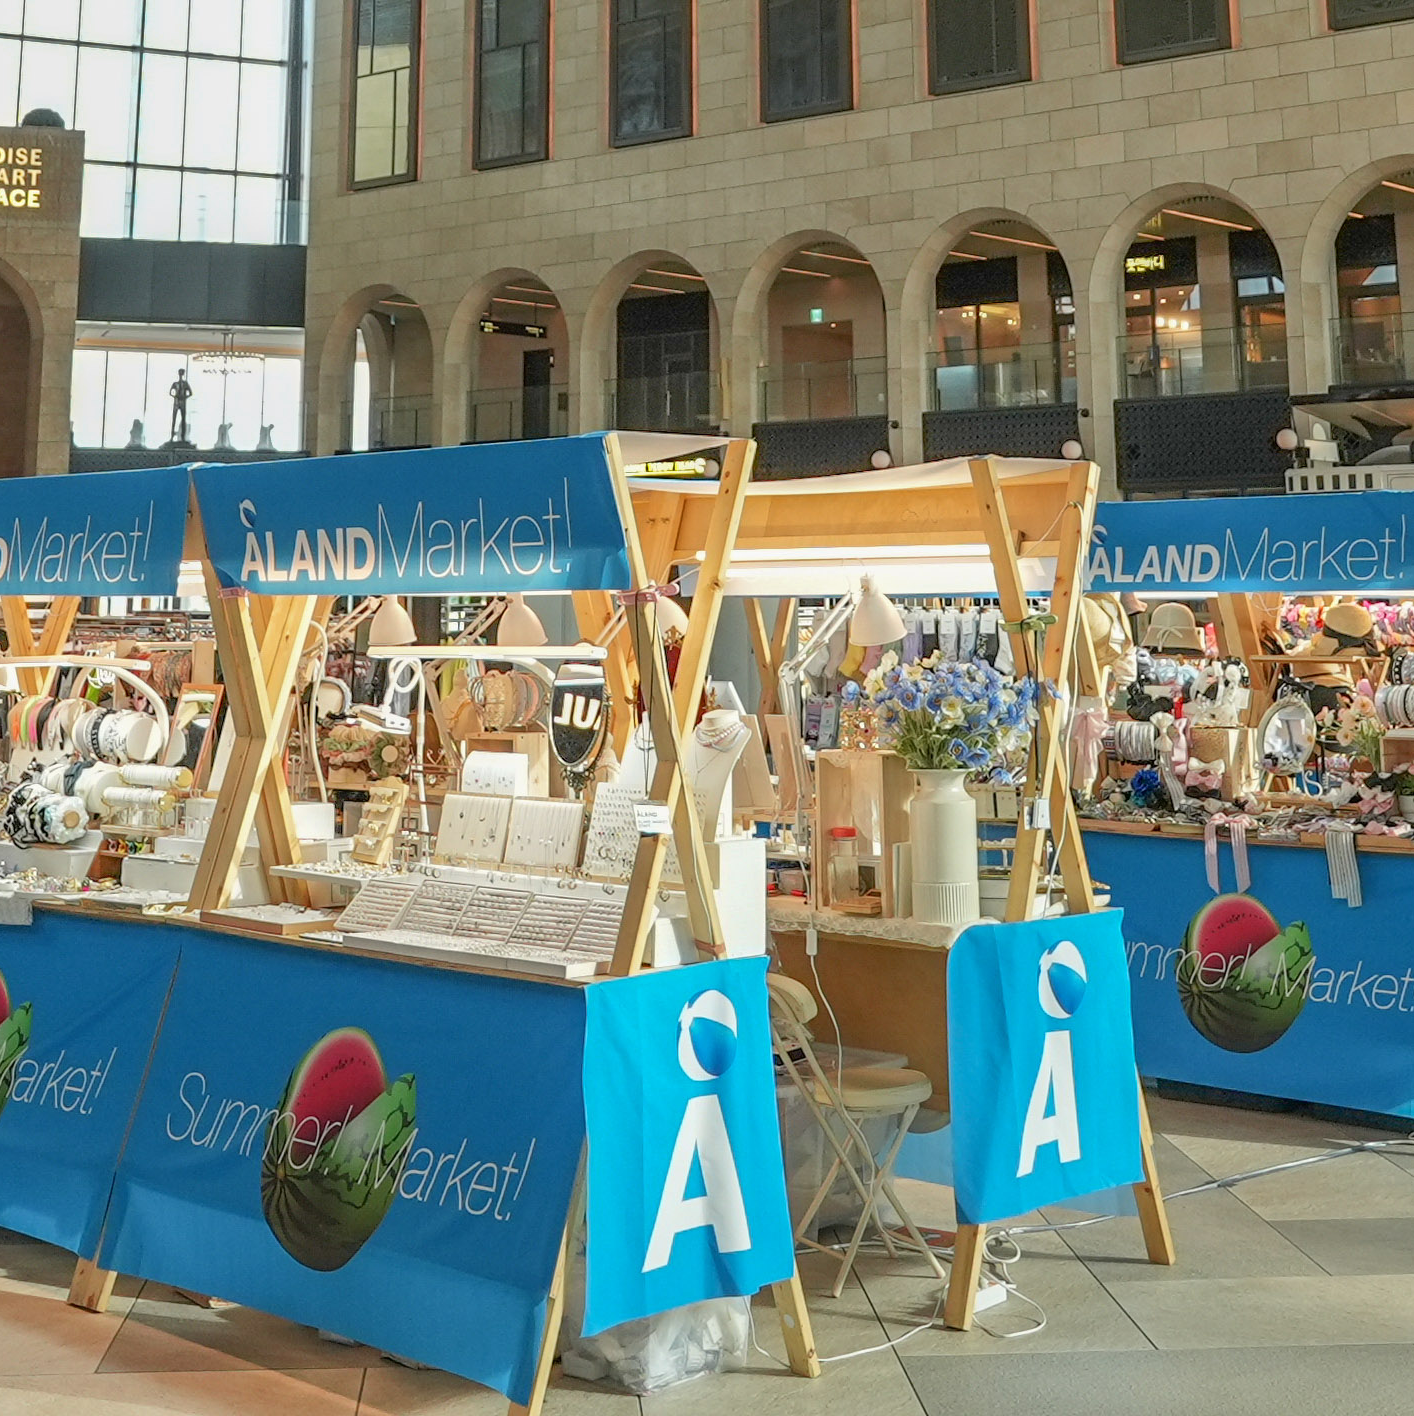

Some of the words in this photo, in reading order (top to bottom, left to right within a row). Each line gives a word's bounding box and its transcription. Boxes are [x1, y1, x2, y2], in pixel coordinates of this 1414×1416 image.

[6, 499, 154, 583] Market!
[377, 476, 573, 579] Market!
[1220, 513, 1406, 582] Market!
[1127, 941, 1252, 992] mmer!
[166, 1071, 354, 1177] Summer!
[356, 1119, 537, 1222] Market!
